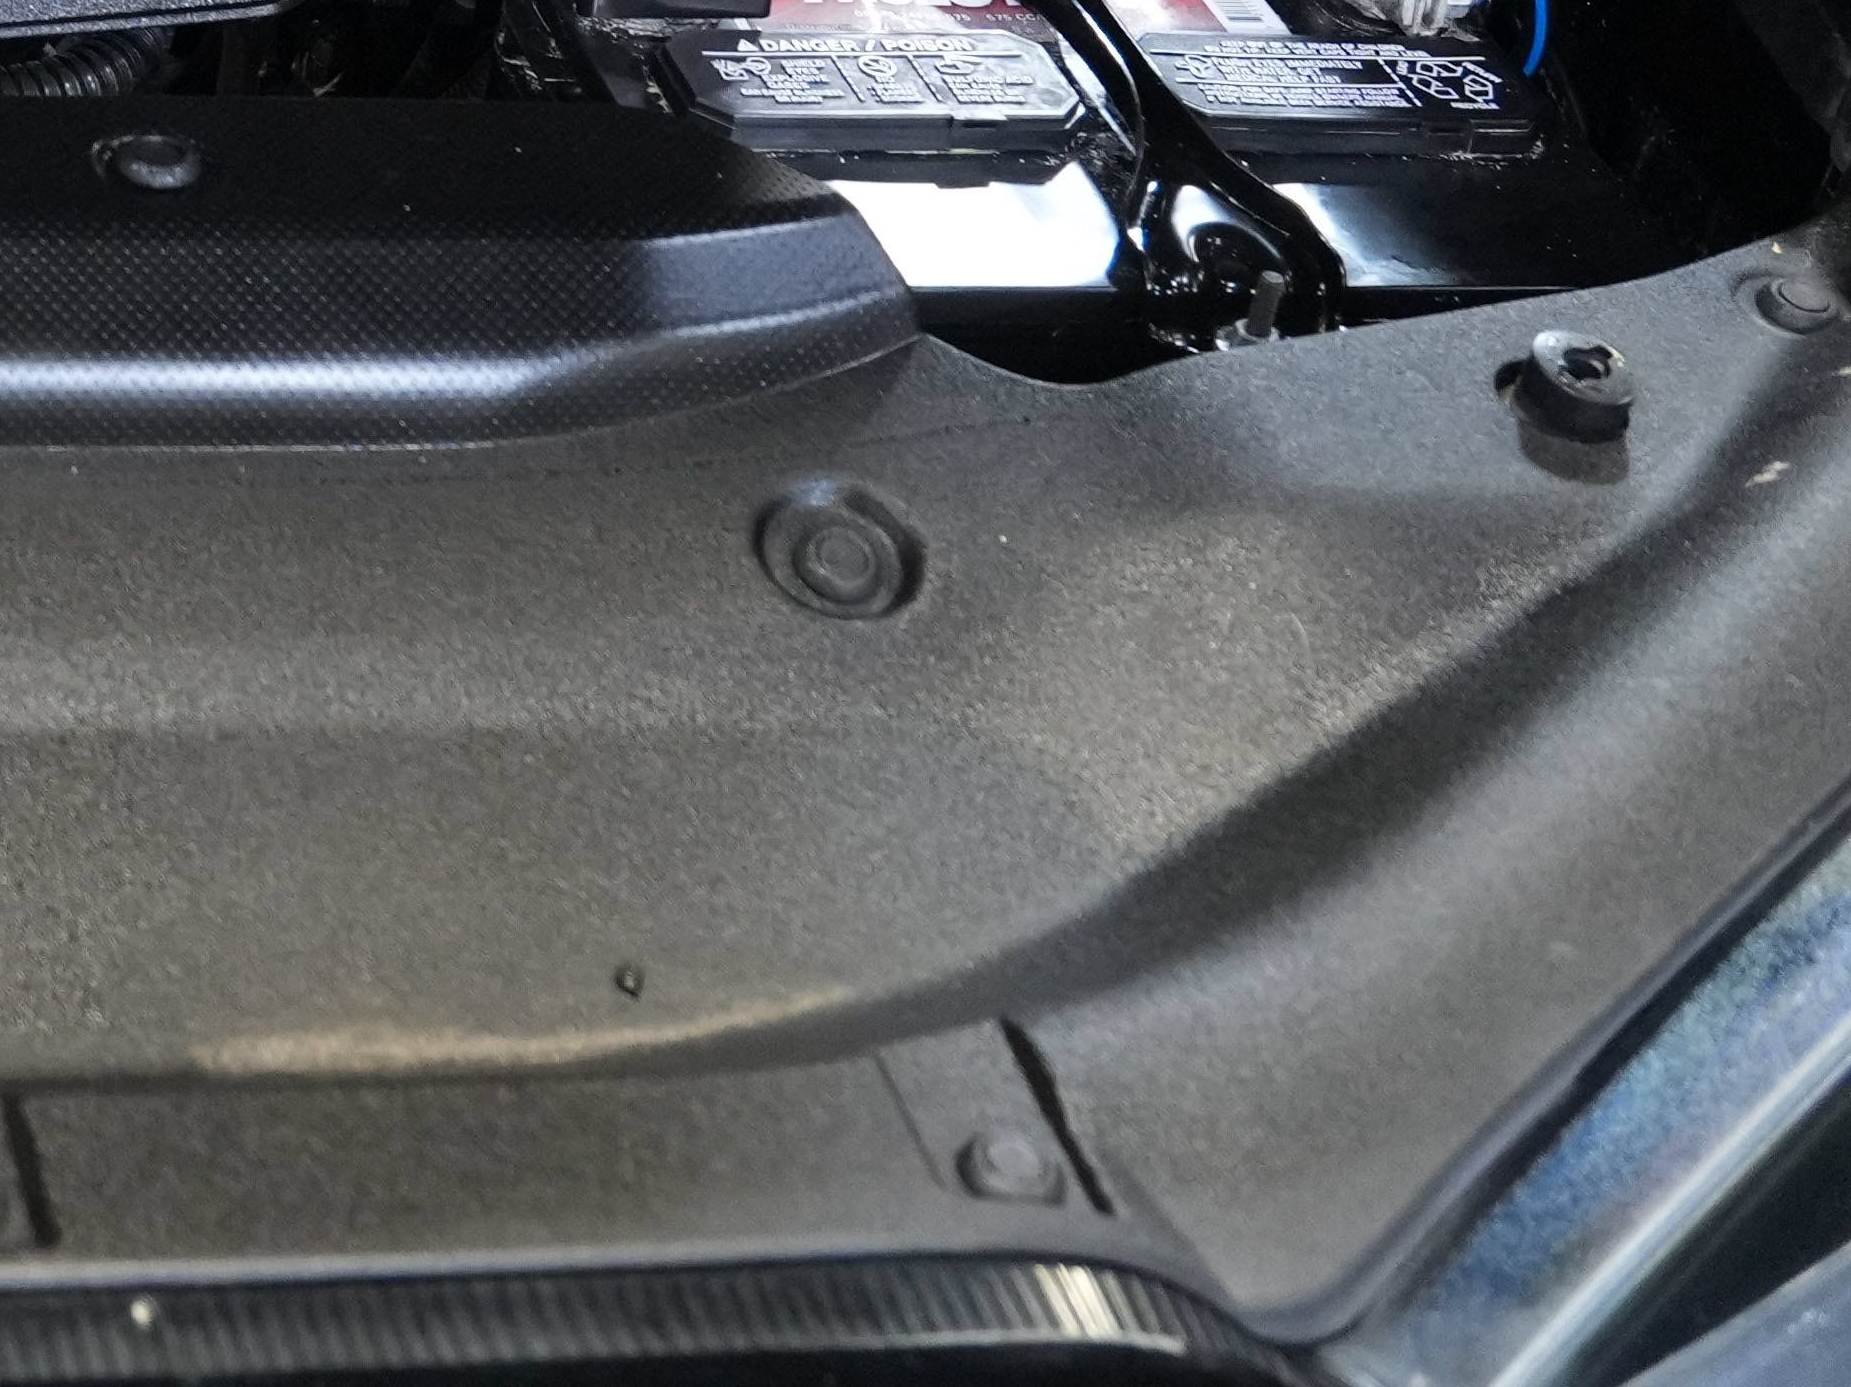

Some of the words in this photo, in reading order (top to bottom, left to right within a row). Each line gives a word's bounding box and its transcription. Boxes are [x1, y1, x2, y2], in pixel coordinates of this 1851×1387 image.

[760, 39, 861, 52] DANGER
[864, 39, 876, 52] /
[879, 39, 975, 52] POISON
